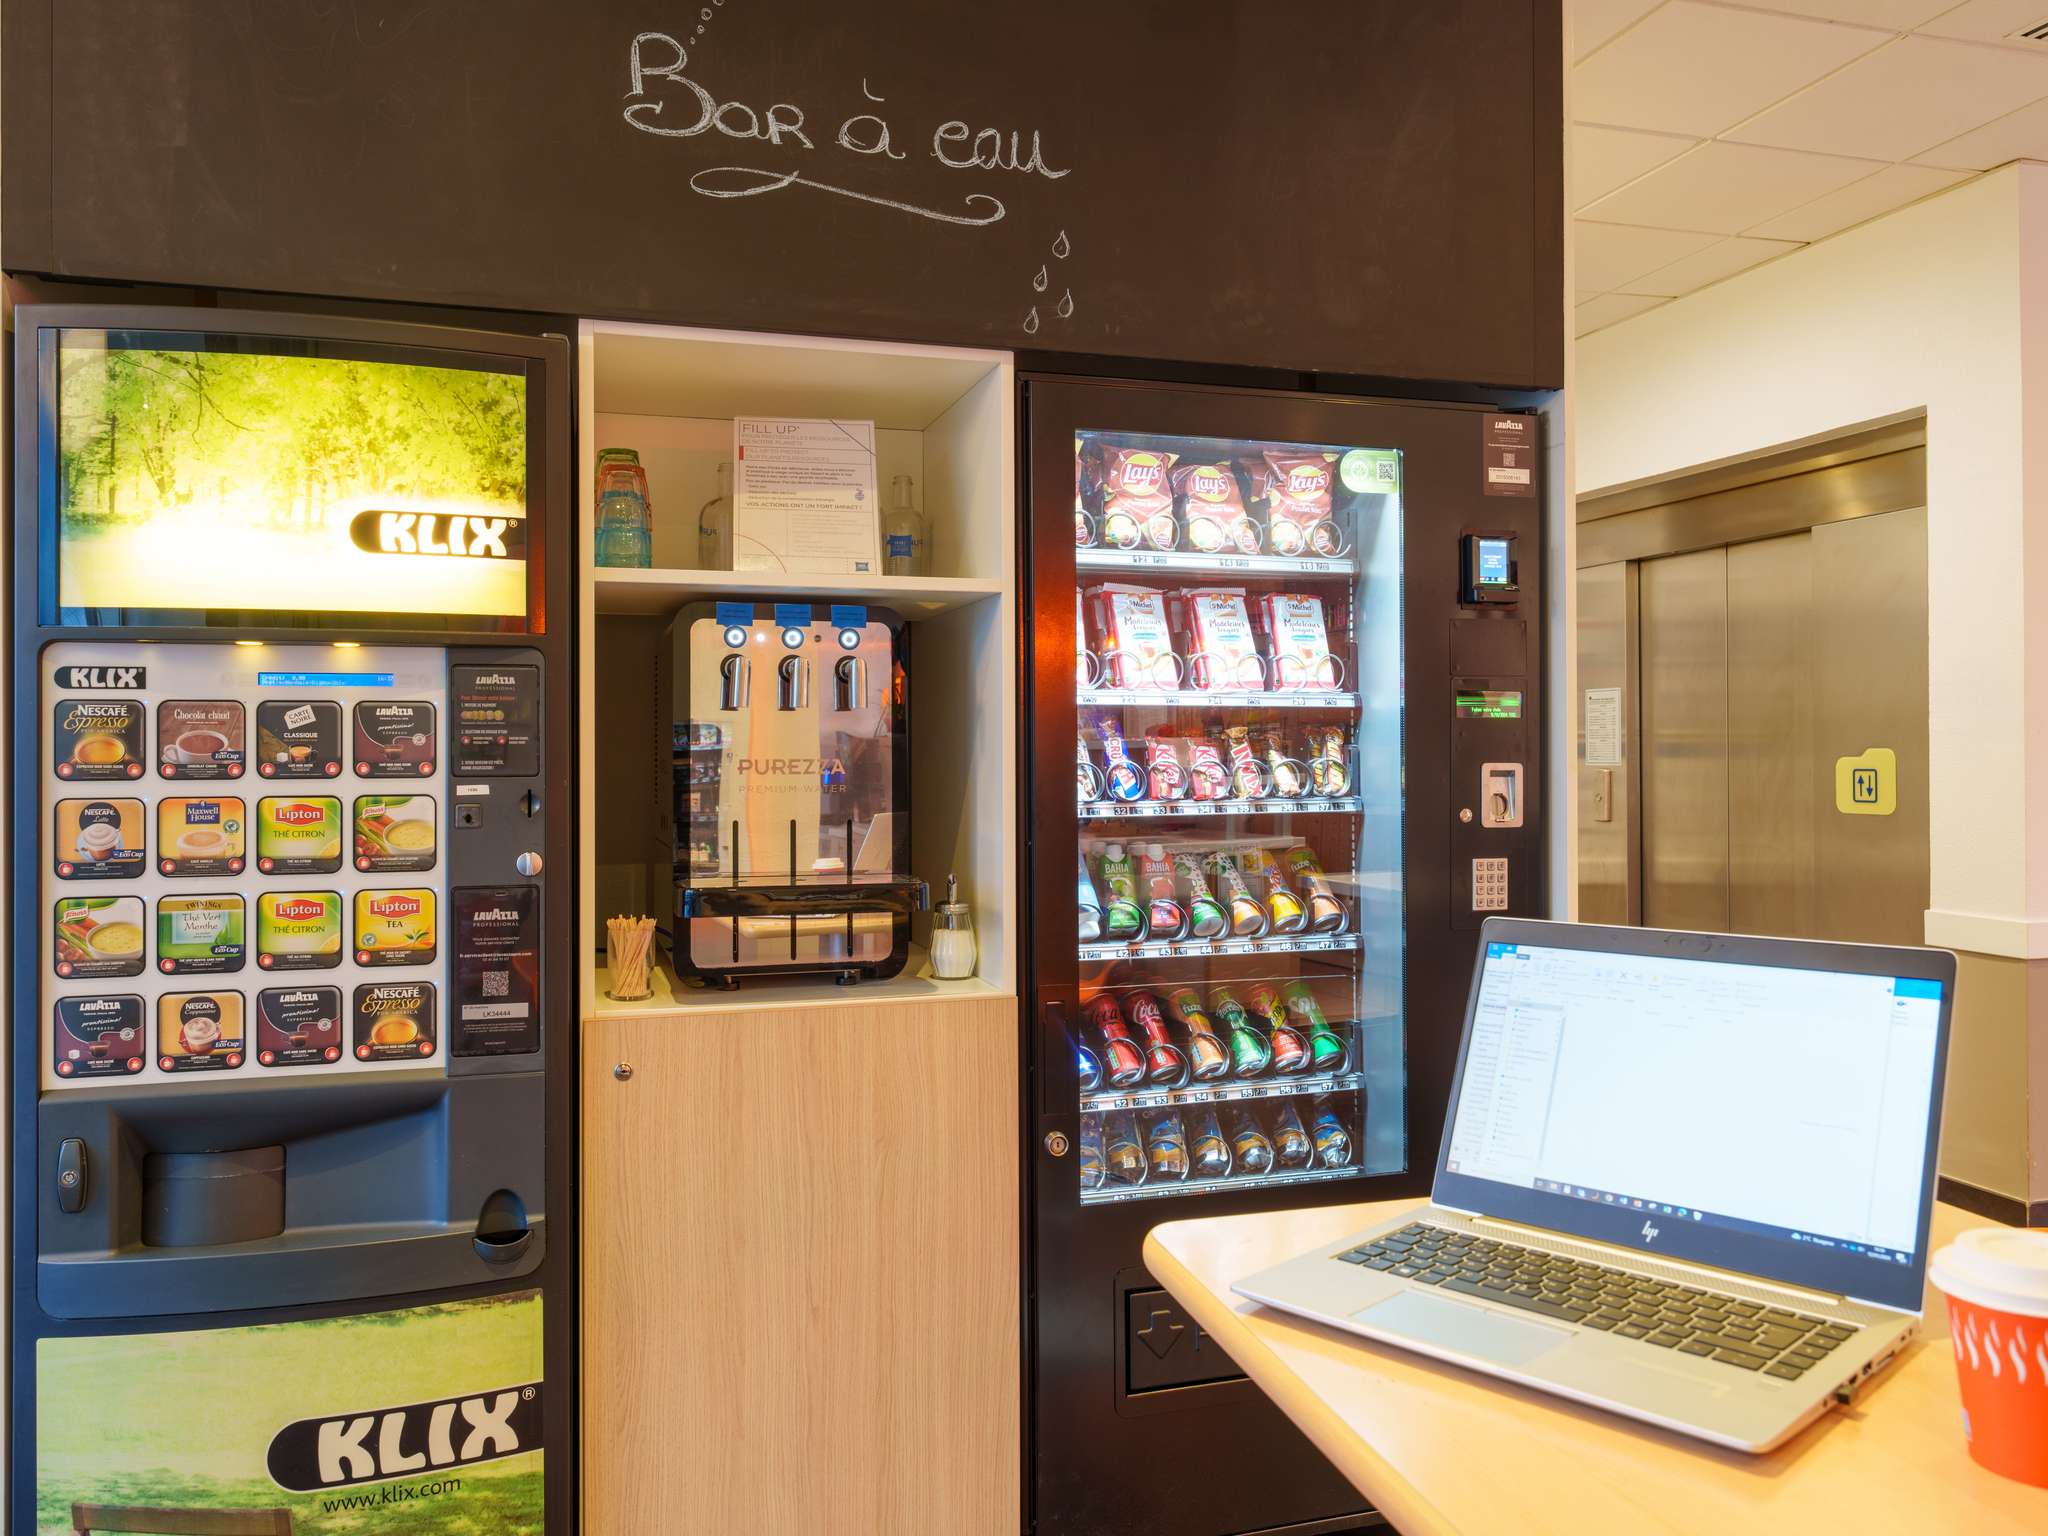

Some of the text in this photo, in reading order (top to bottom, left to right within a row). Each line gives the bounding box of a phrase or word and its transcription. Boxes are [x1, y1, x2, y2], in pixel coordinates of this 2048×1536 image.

[834, 78, 906, 159] à
[931, 120, 1072, 179] eau
[742, 423, 772, 434] FILL
[379, 512, 508, 557] KLIX
[70, 668, 138, 689] KLIX
[475, 674, 516, 685] LAVAZZA
[77, 704, 128, 717] NESCAFÉ
[173, 708, 231, 721] Chocolat chaud
[287, 708, 311, 721] CARTE
[375, 705, 414, 717] LAVAZZA
[64, 710, 129, 735] Espresso
[290, 714, 313, 727] NOIRE
[737, 758, 847, 776] PUREZZA
[738, 783, 848, 793] PREMIUM WATER
[85, 807, 116, 816] NESCAFÉ
[187, 807, 219, 816] Maxwell
[191, 814, 216, 822] House
[279, 807, 321, 822] Lipton
[272, 828, 326, 838] THÉ CITRON
[1104, 863, 1129, 874] BAHIA
[1145, 861, 1170, 873] BAHIA
[278, 903, 321, 917] Lipton
[373, 899, 418, 914] Lipton
[182, 912, 201, 922] Thé
[473, 908, 520, 921] LAVAZZA
[183, 922, 219, 932] Menthe
[273, 925, 326, 934] THÉ CITRON
[386, 920, 404, 929] TEA
[279, 991, 319, 1003] LAVAZZA
[373, 985, 420, 1000] NESCAFÉ
[79, 999, 121, 1012] LAVAZZA
[185, 1002, 216, 1011] NESCAFÉ
[361, 993, 422, 1017] Espresso
[1641, 1220, 1660, 1243] hp
[317, 1390, 520, 1484] KLIX
[323, 1478, 462, 1514] www.klix.com
